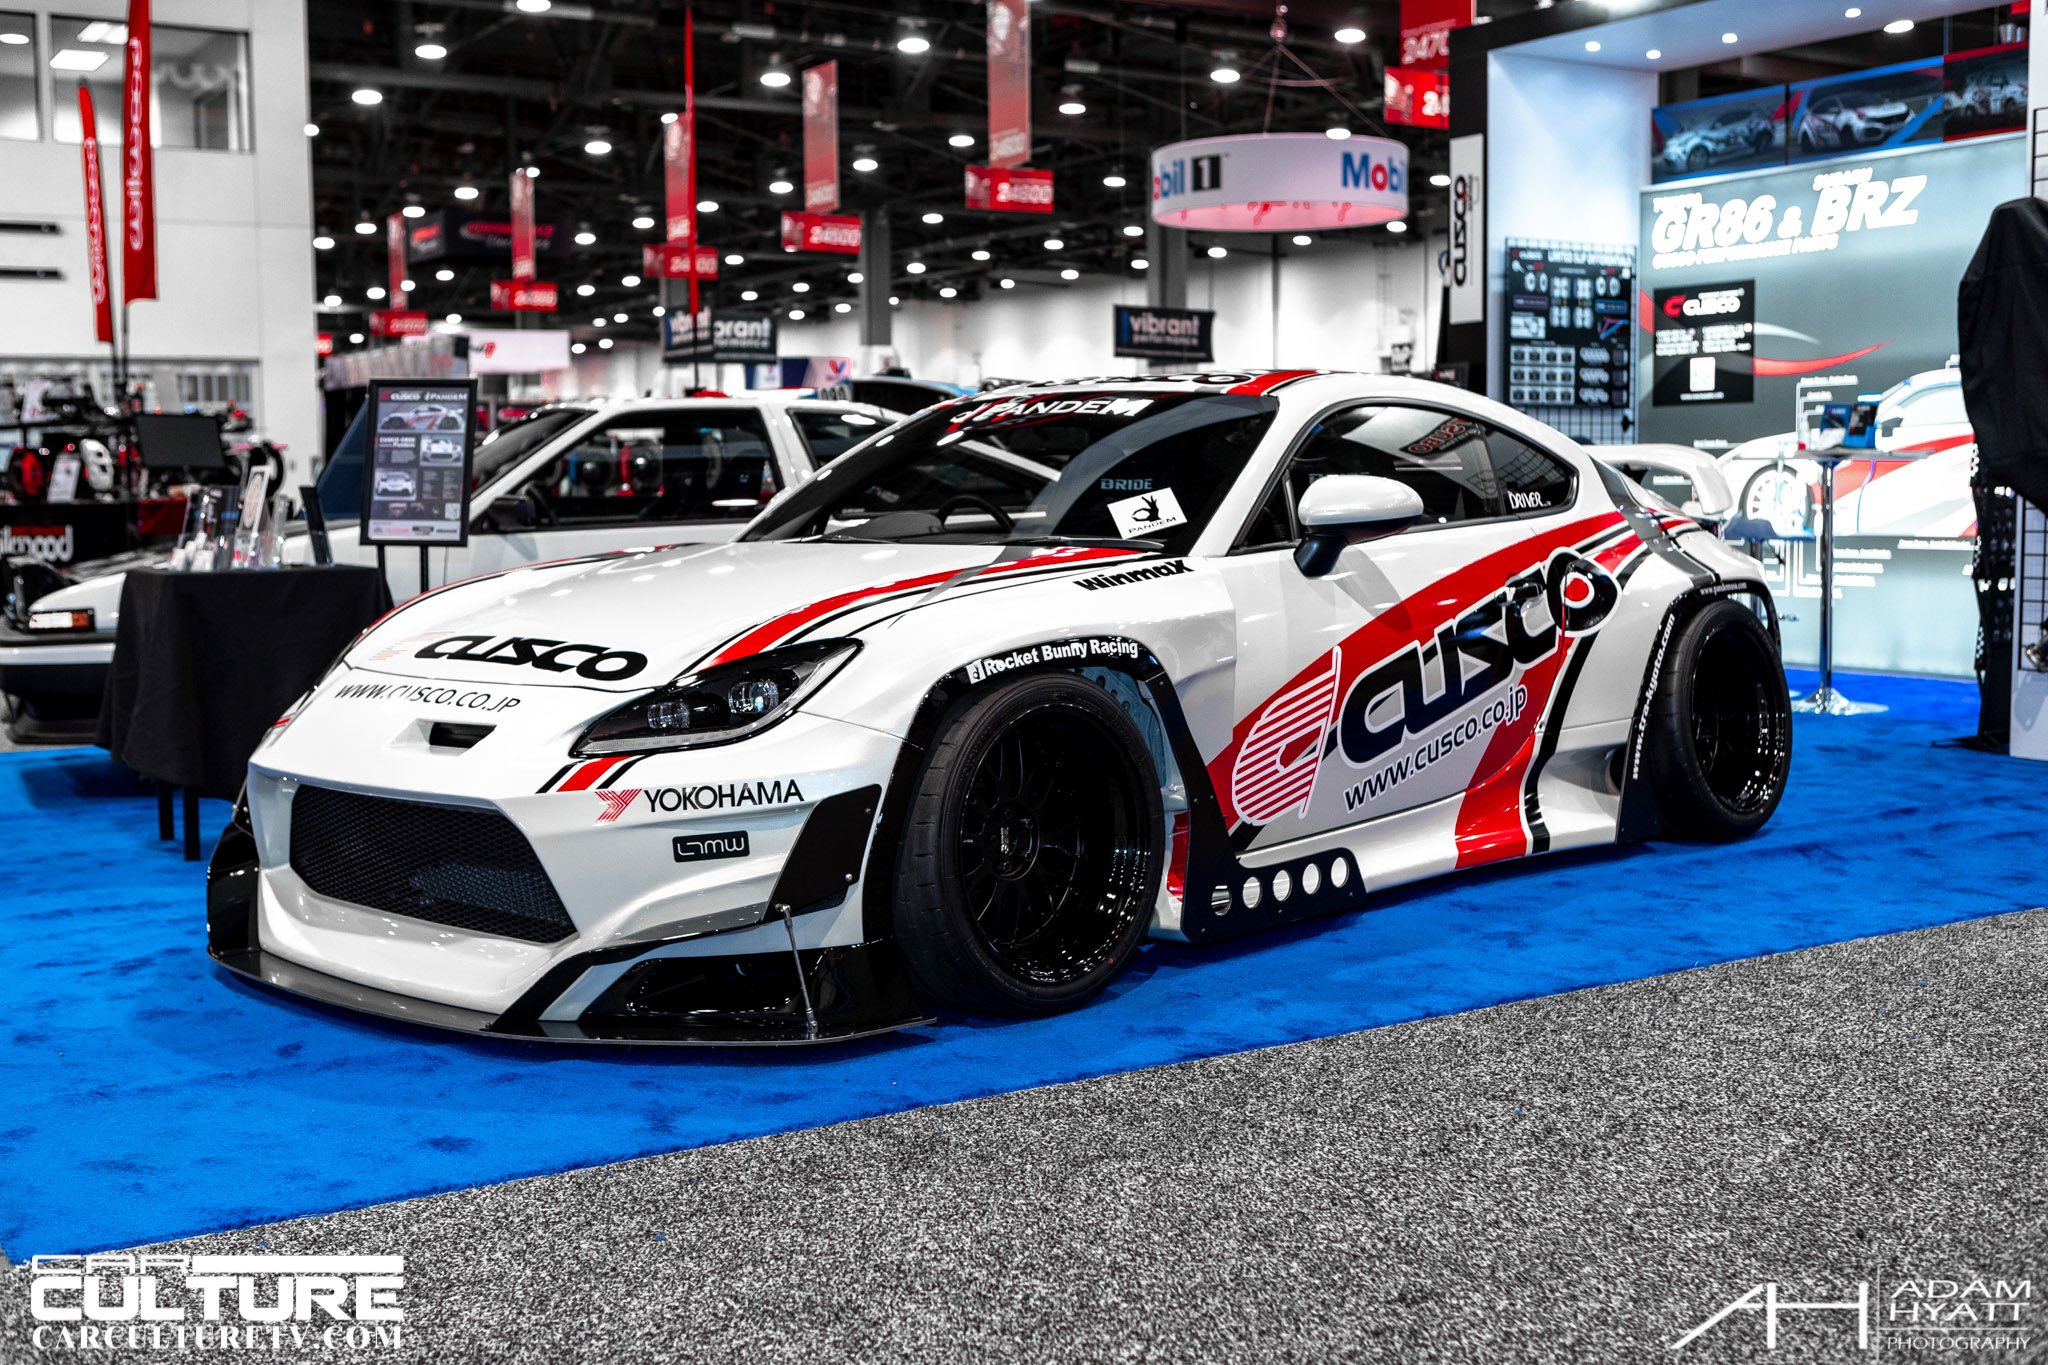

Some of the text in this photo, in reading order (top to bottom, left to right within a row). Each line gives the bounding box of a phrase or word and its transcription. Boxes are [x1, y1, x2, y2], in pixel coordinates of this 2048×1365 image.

[1651, 175, 1927, 253] GR86 & BRZ
[1129, 311, 1199, 335] vibrant
[1100, 478, 1152, 490] BRIDE
[1128, 516, 1177, 534] PANDEM
[414, 635, 648, 681] CUSCO
[986, 639, 1139, 676] Rocket Bunny Racing
[1338, 546, 1623, 770] CUSCO
[1632, 612, 1676, 780] www.tra-kyoto.com
[1343, 684, 1528, 812] www.cusco.co.jp
[644, 779, 805, 812] YOKOHAMA
